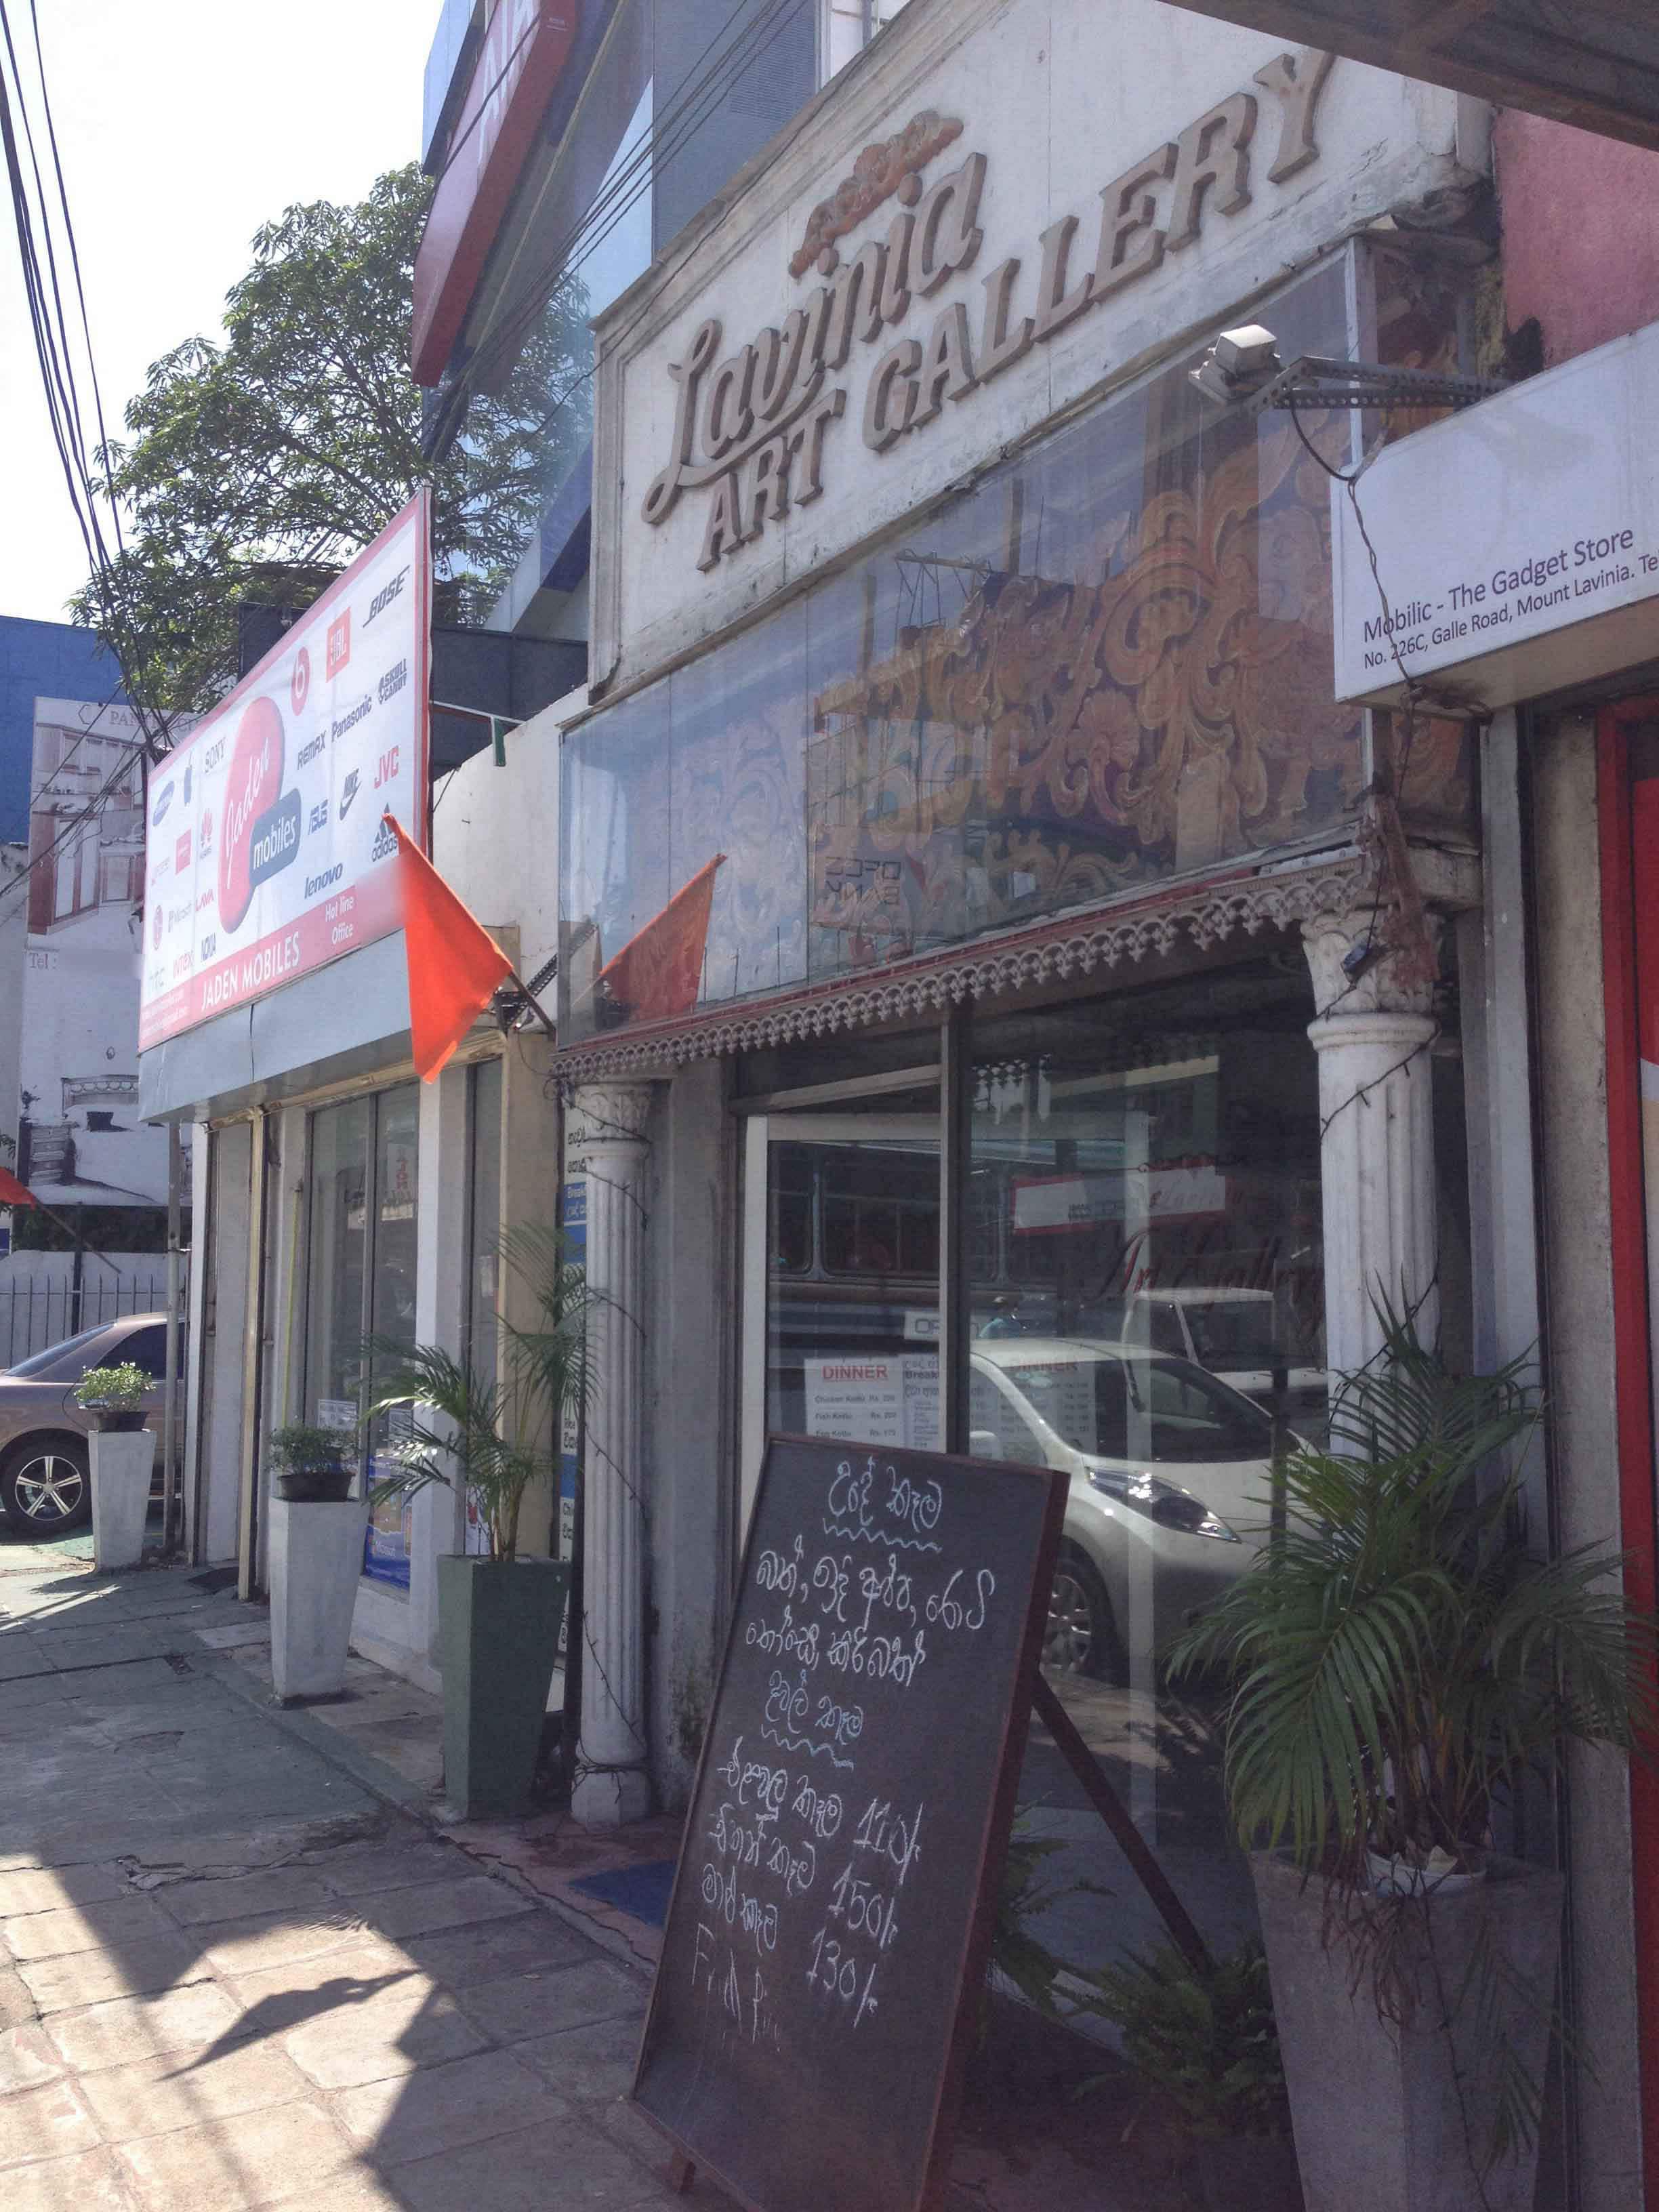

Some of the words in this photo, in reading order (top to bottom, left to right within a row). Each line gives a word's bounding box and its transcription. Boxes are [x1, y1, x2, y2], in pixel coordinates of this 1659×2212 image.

[696, 389, 846, 573] ART
[862, 49, 1338, 452] GALLERY
[641, 152, 986, 526] Lavinia
[363, 565, 410, 628] BOSE
[1364, 601, 1432, 643] Mobilic
[1449, 583, 1486, 611] The
[1492, 550, 1569, 595] Gadget
[1574, 529, 1634, 567] Store
[1364, 651, 1387, 670] No.
[1391, 633, 1428, 661] 226C,
[1431, 617, 1468, 647] Galle
[1471, 603, 1513, 634] Road,
[1517, 585, 1571, 618] Mount
[1574, 564, 1635, 598] Lavinia.
[330, 625, 347, 666] JBL
[331, 693, 373, 743] Panasonic
[205, 737, 226, 774] SONY
[297, 729, 327, 771] REMAX
[373, 745, 400, 790] JVC
[226, 737, 270, 890] Jaden
[253, 815, 298, 872] mobiles
[371, 834, 398, 863] adidas
[194, 888, 215, 912] LAVA
[304, 862, 344, 899] lenovo
[325, 900, 340, 922] Hot
[340, 896, 354, 916] line
[331, 922, 354, 945] Office
[201, 964, 238, 1012] JADEN
[242, 931, 300, 993] MOBILES
[822, 1365, 888, 1380] DINNER
